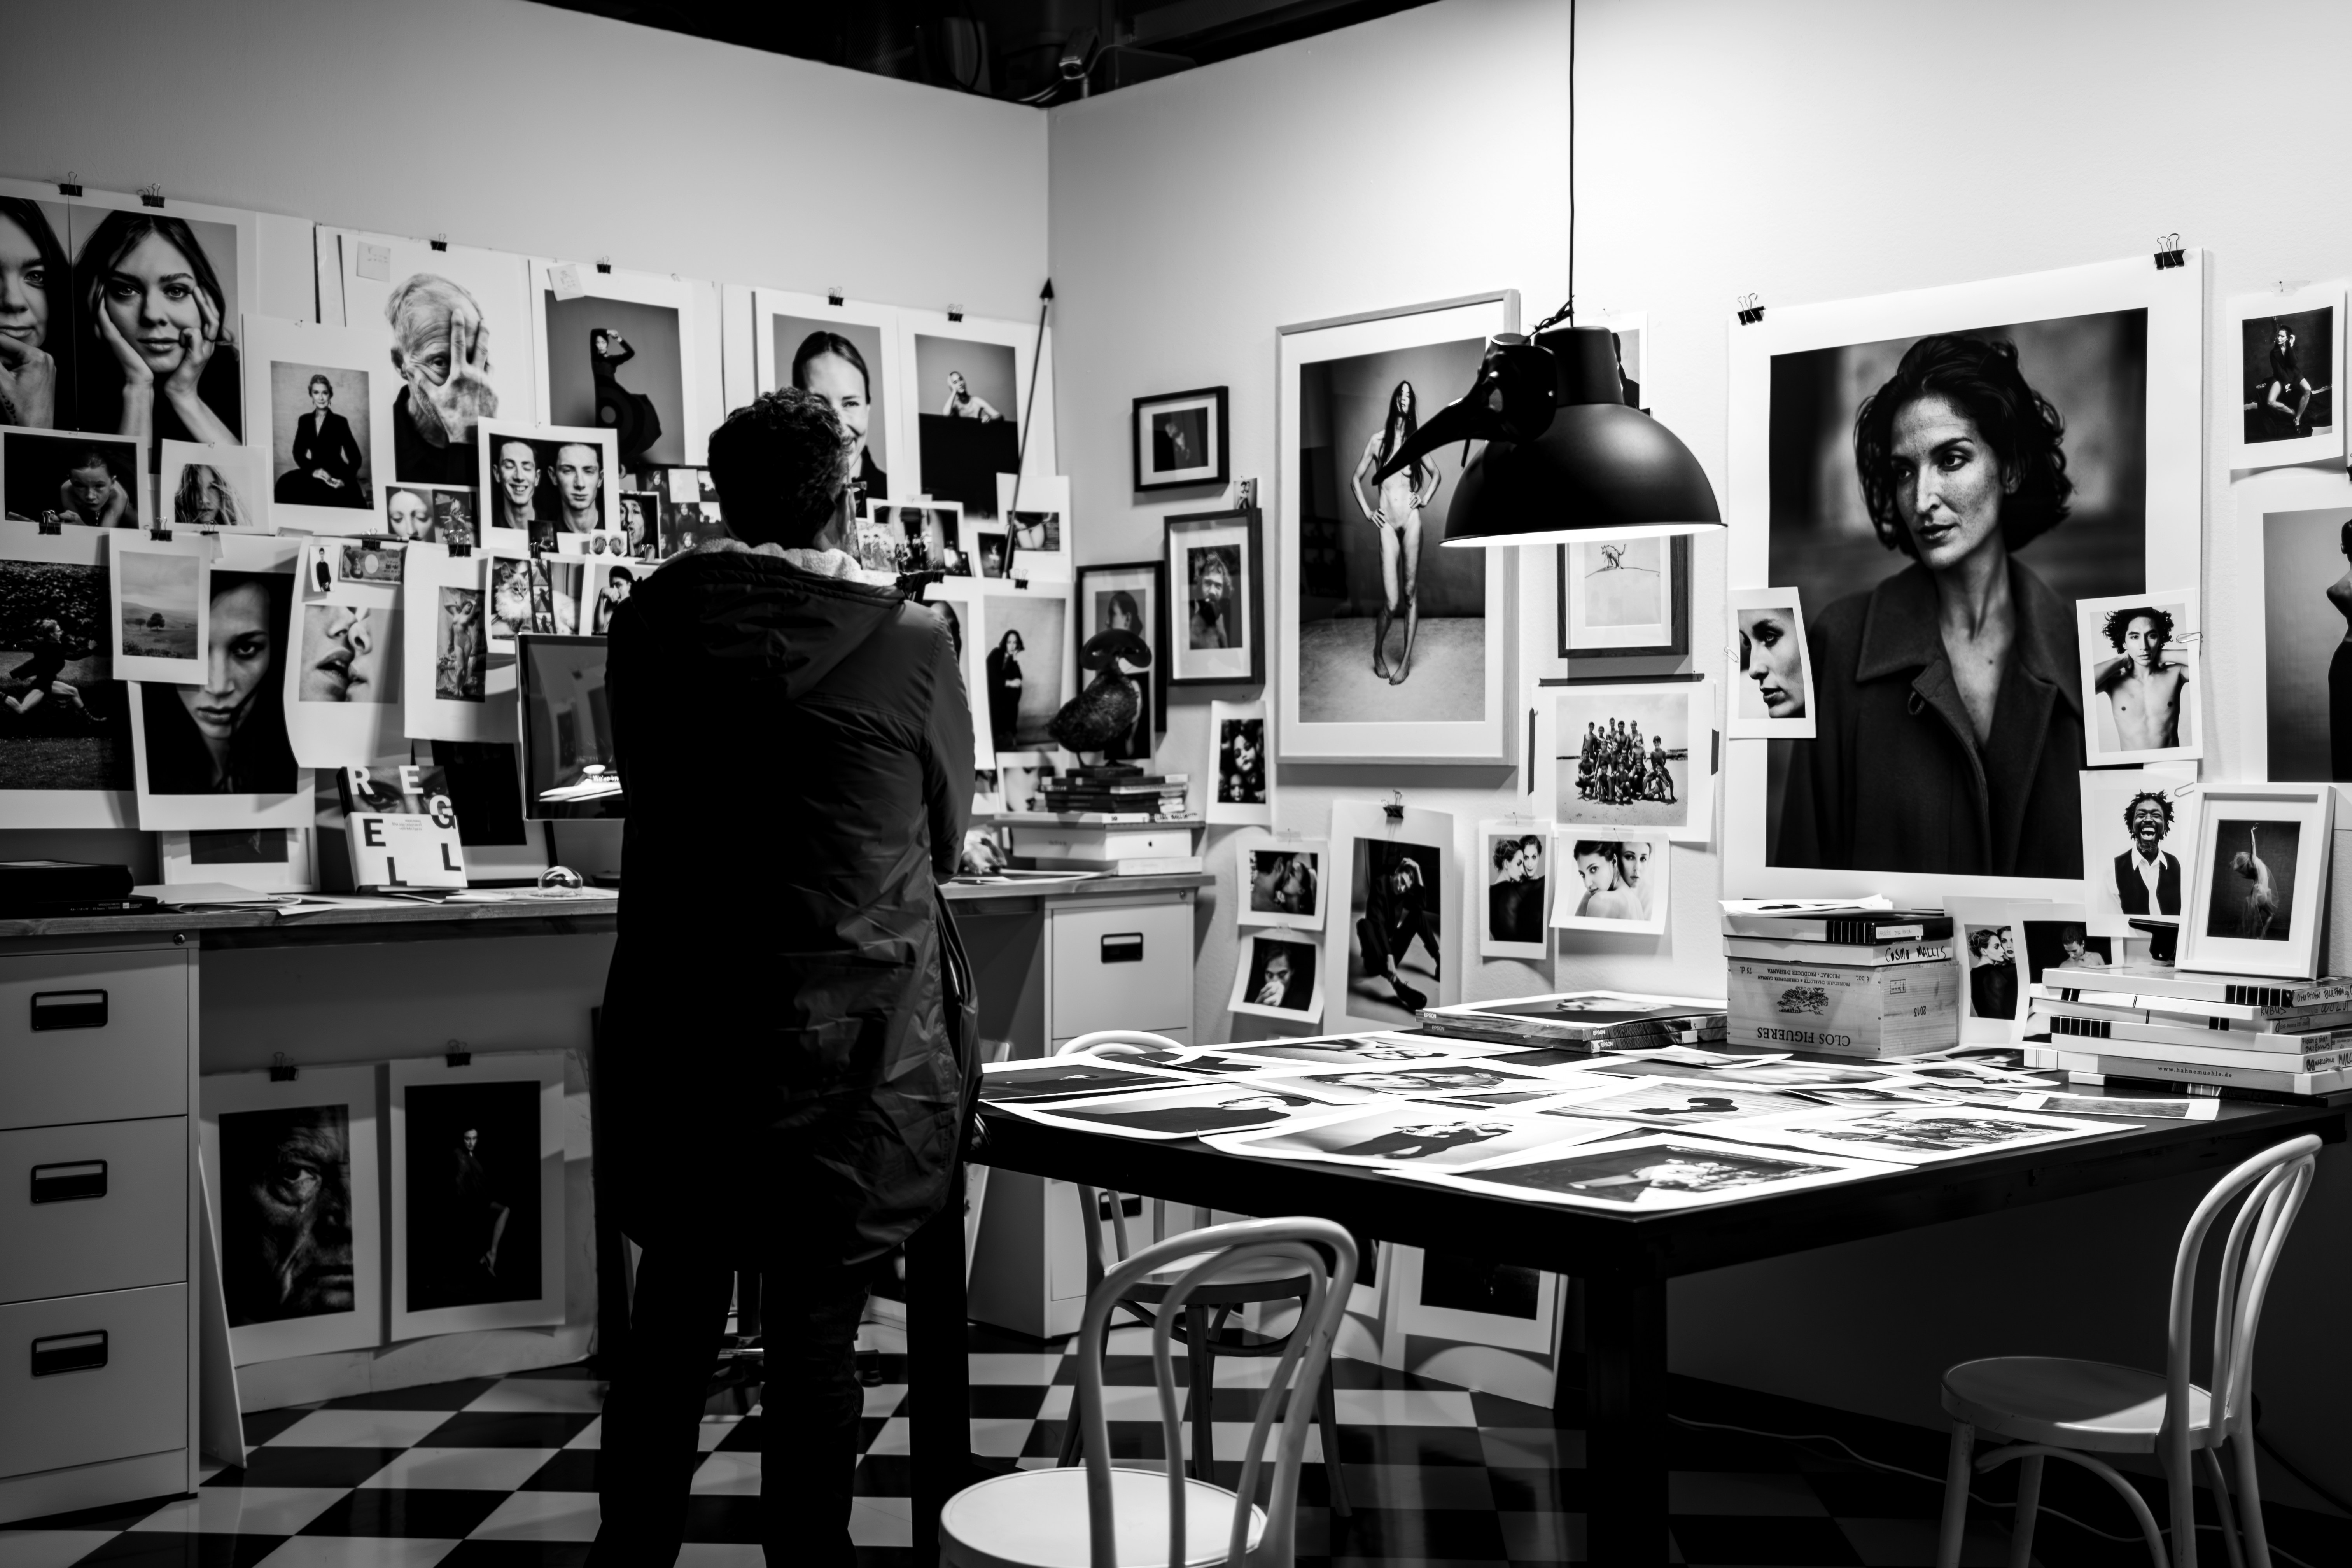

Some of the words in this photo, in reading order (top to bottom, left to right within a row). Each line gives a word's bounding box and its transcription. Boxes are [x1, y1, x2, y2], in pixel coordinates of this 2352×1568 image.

[1885, 947, 1909, 962] COSMO
[1916, 945, 1946, 959] MALLIS
[1855, 975, 1865, 984] bot.
[1914, 1006, 1926, 1017] 2013
[1757, 1027, 1814, 1043] FIGUERES
[1819, 1033, 1850, 1046] CLOS
[2158, 1067, 2232, 1078] www.hahnemuehle.de
